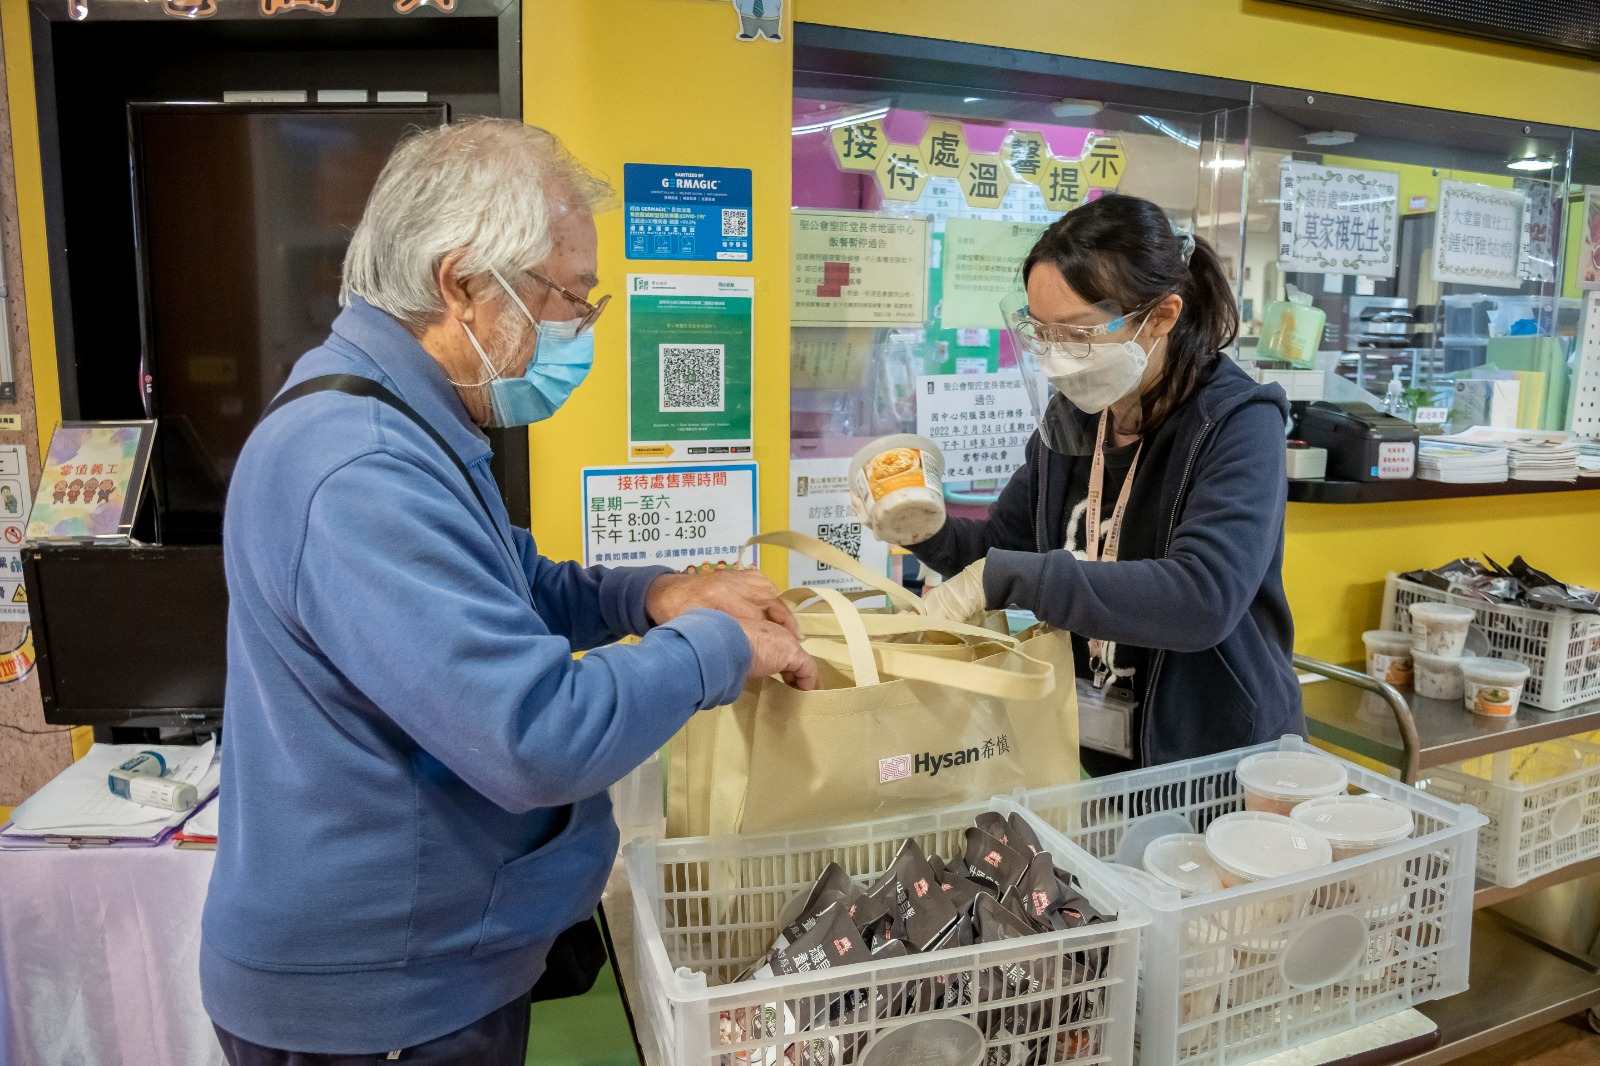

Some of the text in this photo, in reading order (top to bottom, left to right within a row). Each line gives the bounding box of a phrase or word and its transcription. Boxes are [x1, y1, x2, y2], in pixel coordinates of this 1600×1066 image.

[843, 123, 1119, 203] 接待處溫馨提示
[617, 472, 728, 491] 接待處售票時間
[591, 495, 671, 513] 星期一至六
[591, 513, 623, 529] 上午
[628, 512, 660, 527] 8:00
[675, 509, 716, 525] 12:00
[591, 529, 623, 545] 下午
[628, 528, 660, 543] 1:00
[675, 525, 707, 540] 4:30
[914, 734, 1011, 777] Hysan 希慎
